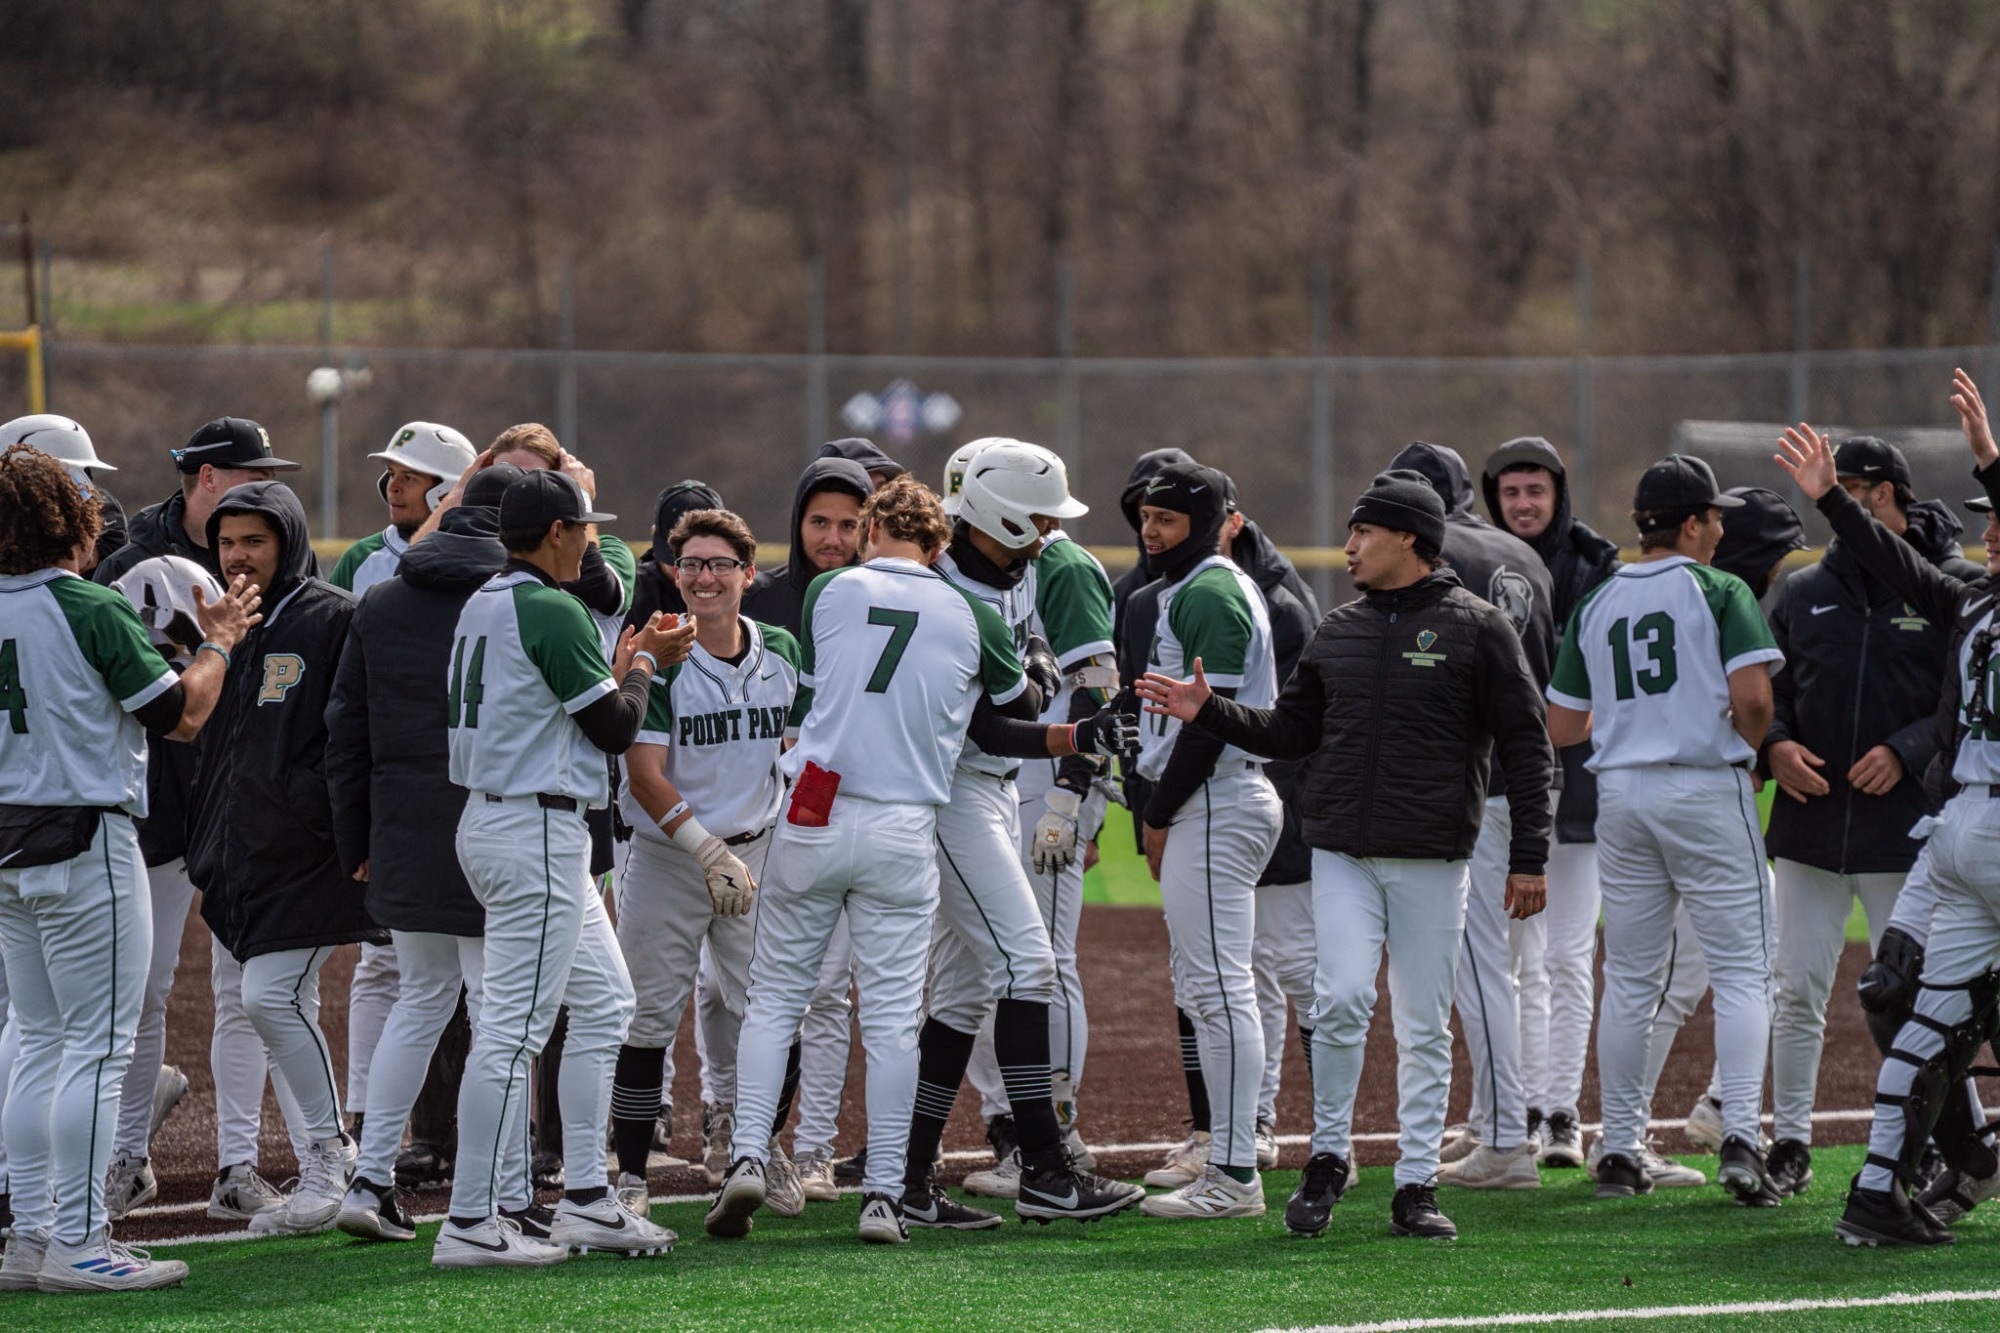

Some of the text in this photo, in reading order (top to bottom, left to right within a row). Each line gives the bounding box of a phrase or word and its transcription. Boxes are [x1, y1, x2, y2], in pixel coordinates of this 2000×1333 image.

[394, 429, 416, 448] P
[950, 470, 964, 495] P
[864, 606, 919, 694] 7
[1608, 611, 1678, 701] 13
[258, 653, 305, 706] P
[679, 709, 742, 746] POINT
